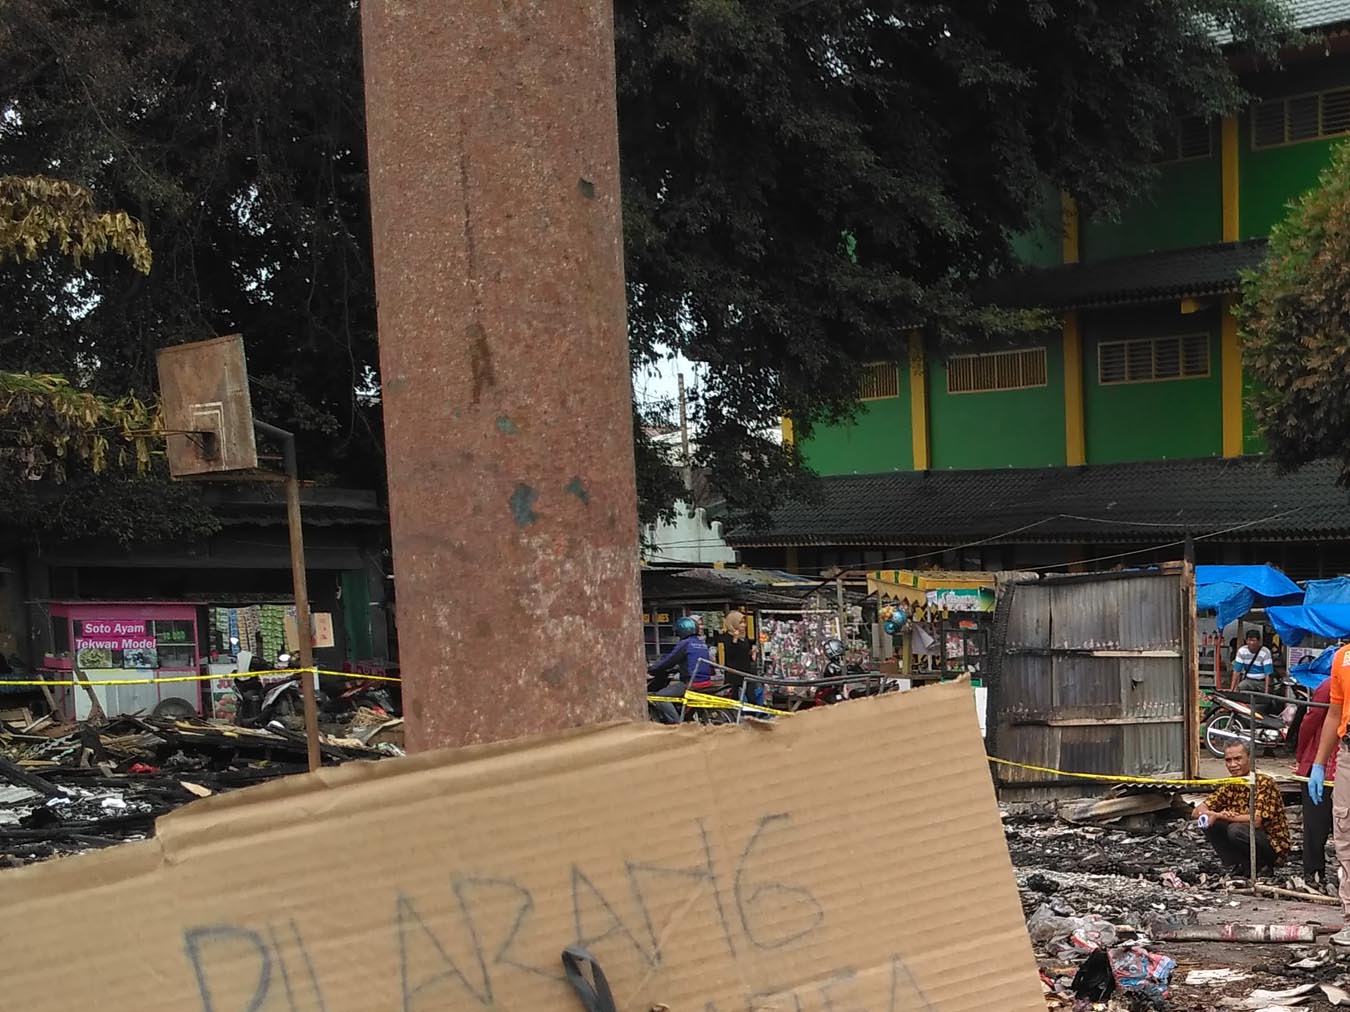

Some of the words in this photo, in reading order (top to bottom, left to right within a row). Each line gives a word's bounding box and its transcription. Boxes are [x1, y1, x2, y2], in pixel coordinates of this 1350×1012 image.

[85, 623, 112, 634] Soto
[114, 623, 145, 635] Ayam
[75, 638, 119, 650] Tekwan
[121, 638, 156, 649] Model
